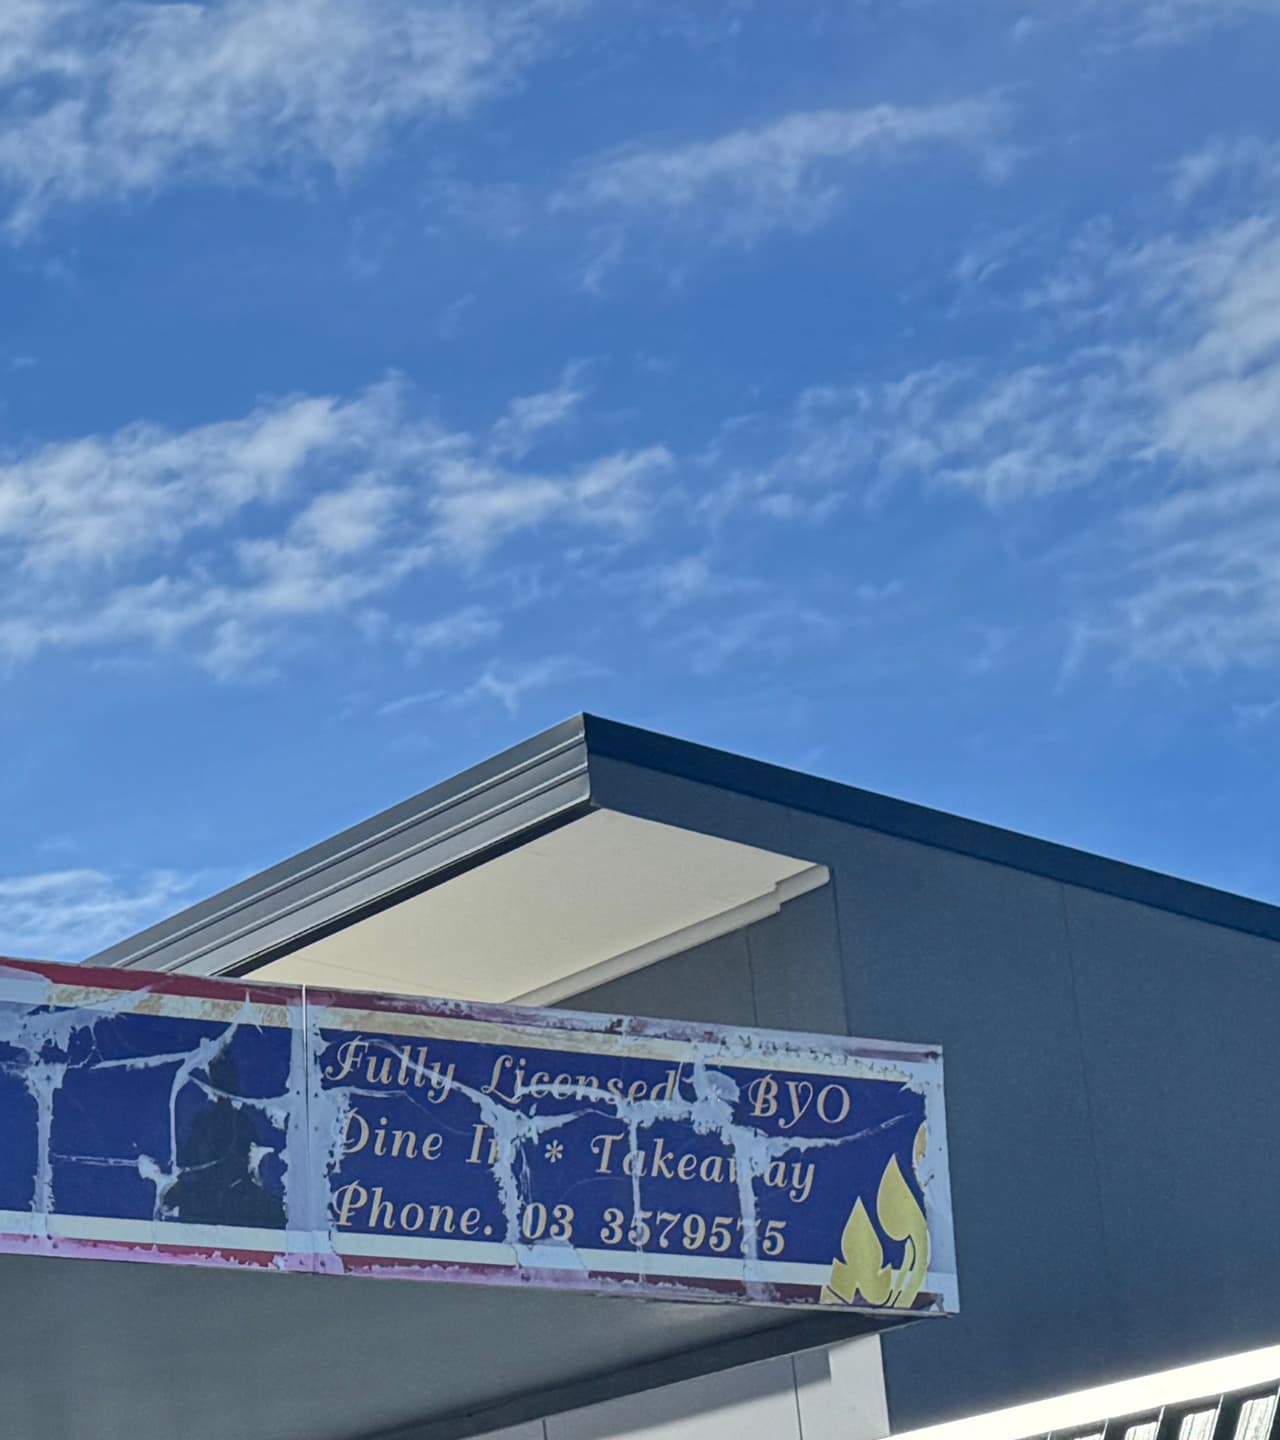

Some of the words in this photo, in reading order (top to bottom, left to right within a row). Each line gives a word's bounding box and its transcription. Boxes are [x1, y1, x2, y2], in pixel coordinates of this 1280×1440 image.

[324, 1035, 456, 1104] Fully
[480, 1055, 678, 1105] Licensed
[748, 1073, 851, 1129] BYO
[341, 1106, 444, 1161] Dine
[590, 1131, 816, 1203] Takeaay
[331, 1179, 493, 1236] Phone.
[521, 1201, 575, 1241] 03
